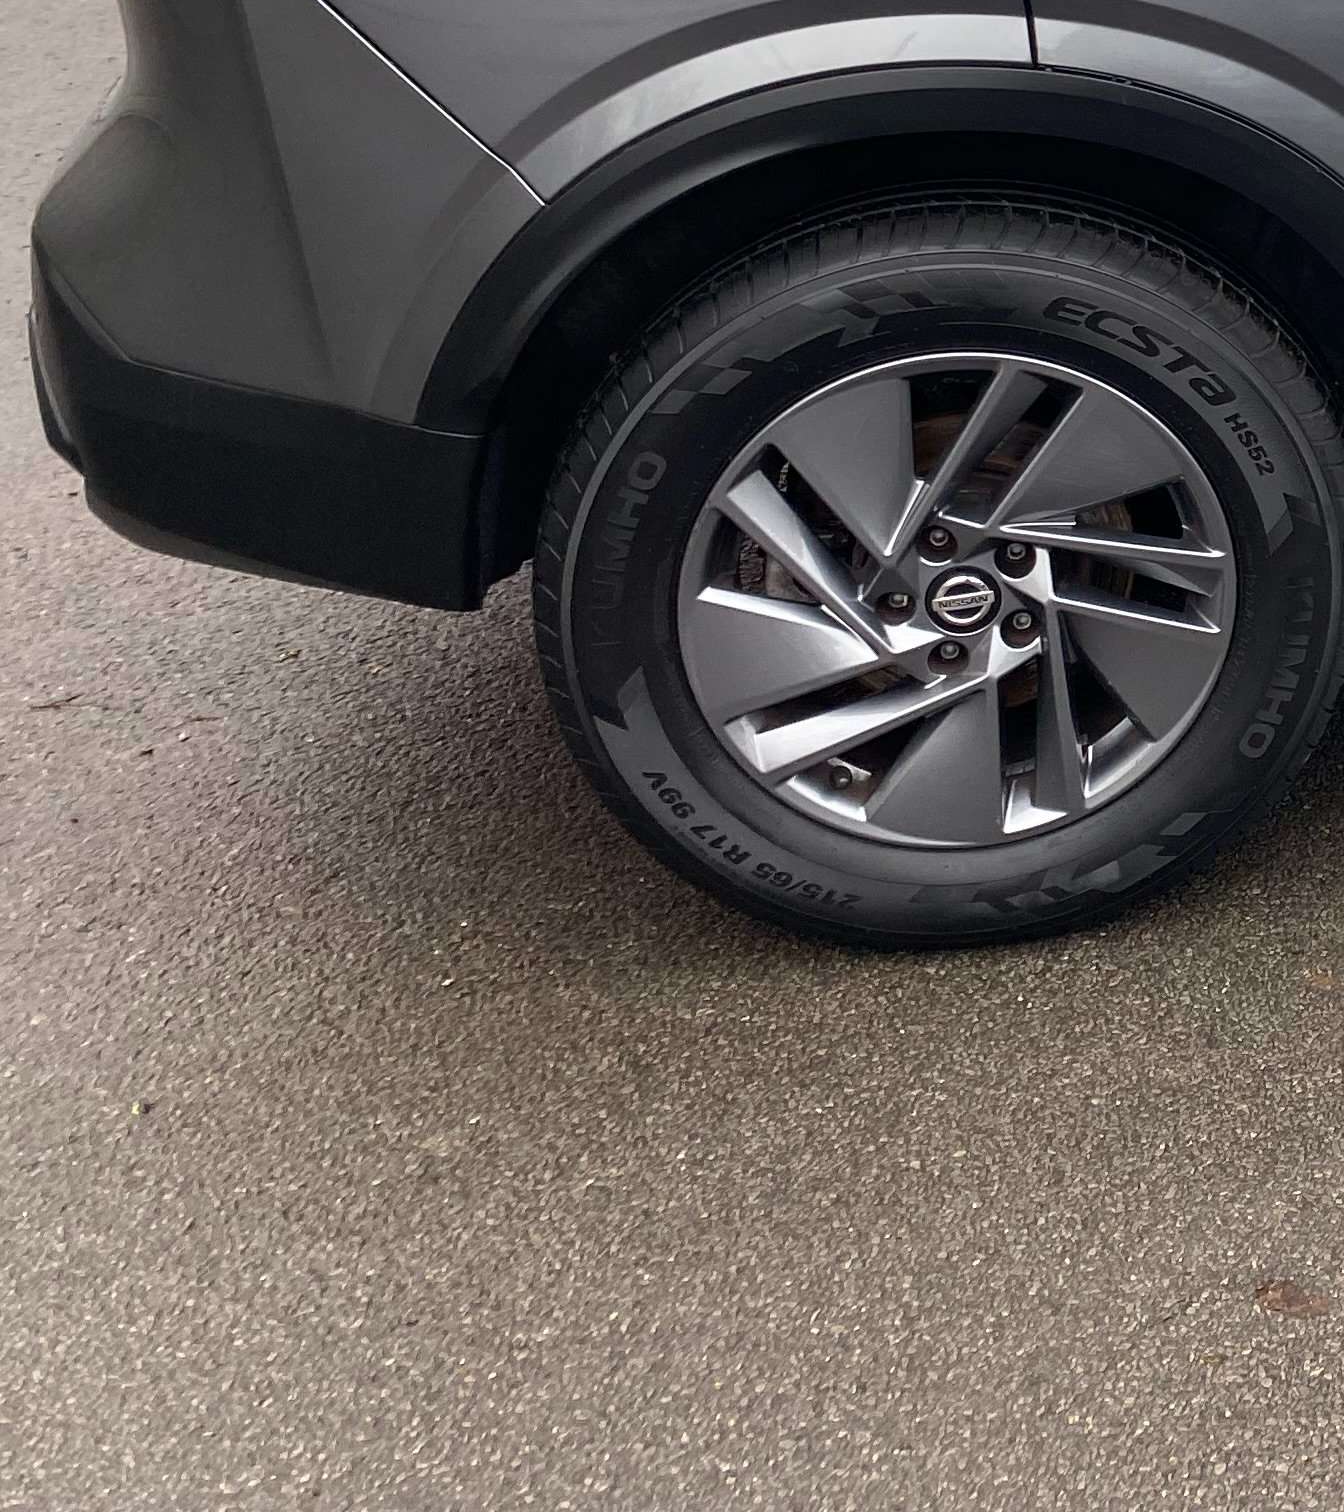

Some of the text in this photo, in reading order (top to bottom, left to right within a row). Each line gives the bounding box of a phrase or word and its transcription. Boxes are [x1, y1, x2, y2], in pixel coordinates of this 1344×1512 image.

[1223, 412, 1276, 477] HS52
[937, 594, 989, 609] NISSAN
[641, 771, 863, 911] 215/65 R17 99V
